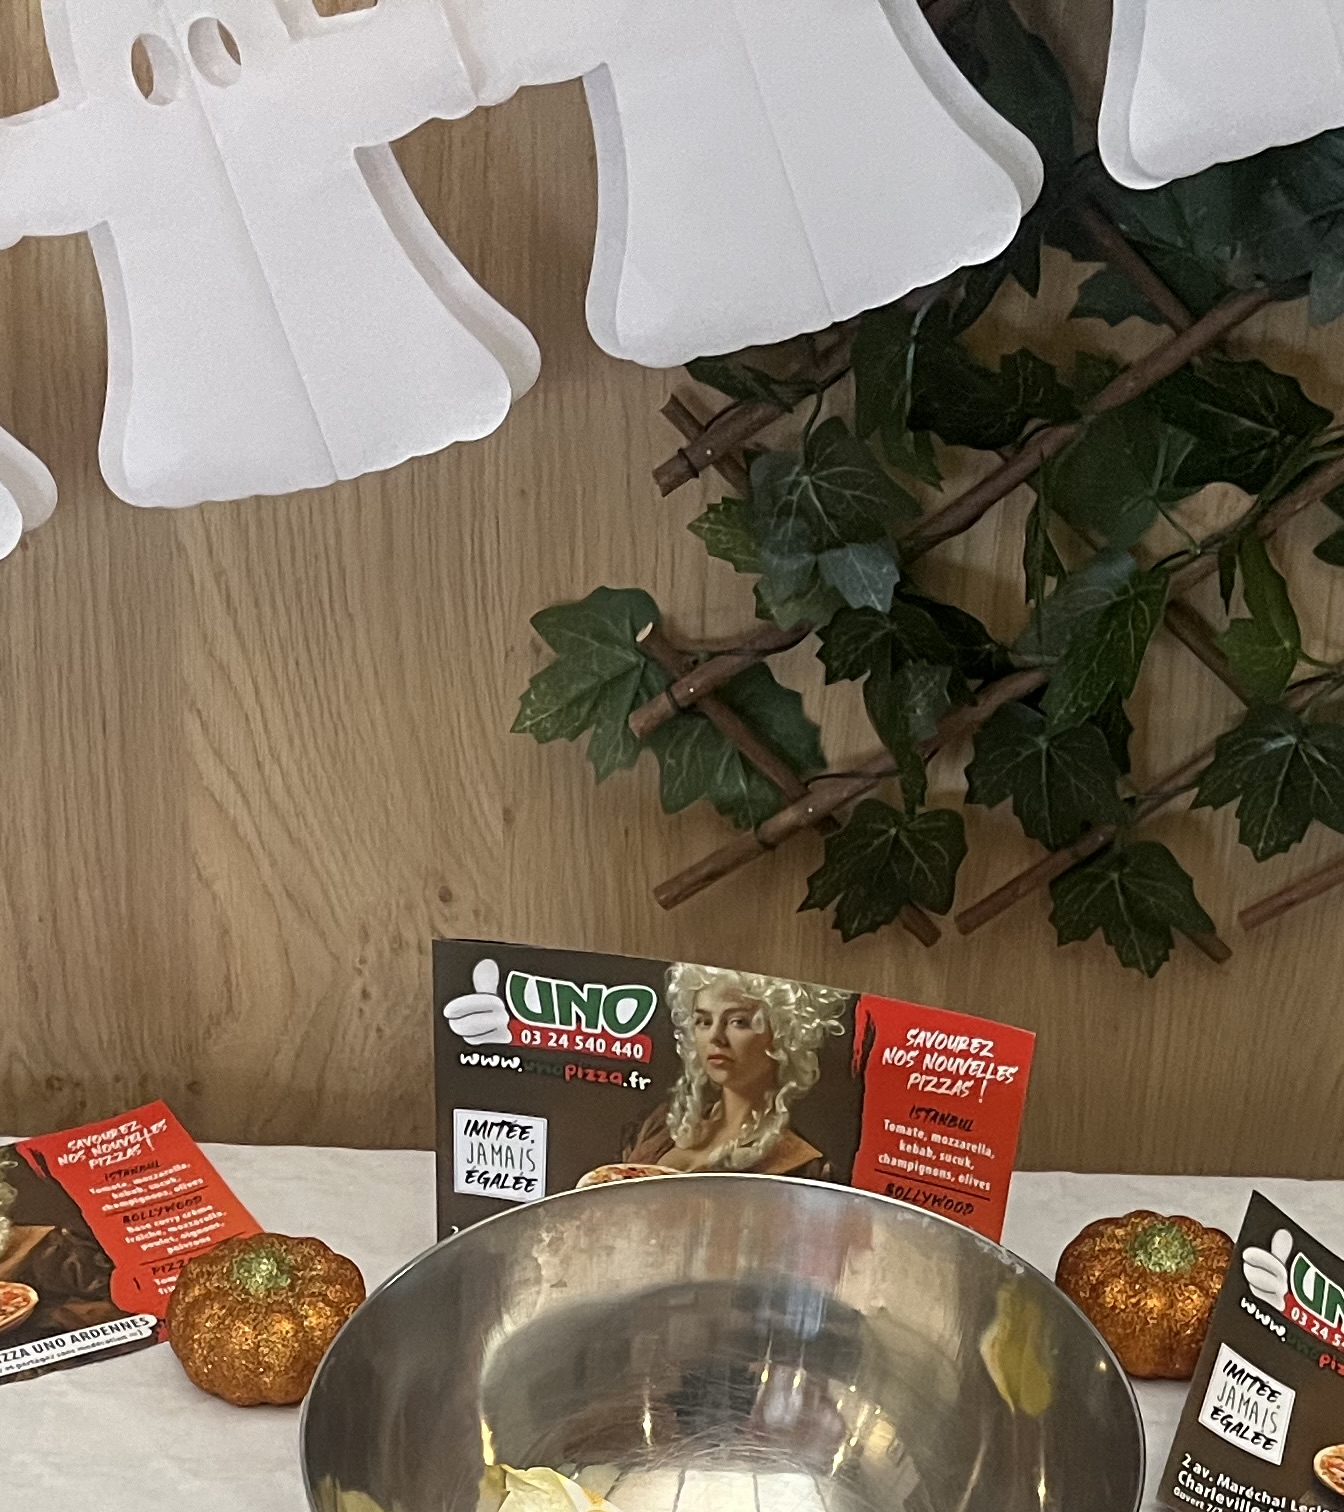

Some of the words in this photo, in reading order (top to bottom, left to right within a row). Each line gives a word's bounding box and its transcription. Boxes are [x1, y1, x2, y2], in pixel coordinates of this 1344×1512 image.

[506, 971, 657, 1037] UNO
[521, 1030, 541, 1045] 03
[548, 1032, 568, 1048] 24
[575, 1037, 605, 1052] 540
[611, 1041, 643, 1058] 440
[906, 1028, 994, 1057] SAVOUREZ
[882, 1047, 919, 1067] NOS
[923, 1053, 1018, 1084] NOUVELLES
[907, 1073, 974, 1097] PIZZAS
[909, 1105, 975, 1132] ISTANBUL
[58, 1150, 86, 1166] NOS
[91, 1119, 167, 1157] NOUVELLES
[68, 1121, 141, 1150] SAVOUREZ
[884, 1119, 928, 1141] Tomate,
[931, 1133, 995, 1159] mozzarella,
[89, 1144, 141, 1169] PIZZAS
[467, 1142, 536, 1172] JAMAIS
[899, 1140, 936, 1160] kebab,
[940, 1152, 975, 1170] sucuk,
[465, 1166, 537, 1192] ÉGALÉE
[878, 1153, 955, 1182] champignons,
[958, 1173, 991, 1191] olives
[123, 1195, 202, 1223] BOLLYWOOD
[884, 1183, 974, 1216] BOLLYWOOD
[152, 1259, 192, 1275] PIZZ
[31, 1339, 66, 1353] UNO
[70, 1317, 150, 1344] ARDENNES
[1291, 1307, 1308, 1325] 03
[1311, 1323, 1328, 1339] 24
[1216, 1382, 1278, 1434] JAMAIS
[1182, 1454, 1192, 1468] 2
[1193, 1464, 1214, 1482] av.
[1216, 1474, 1286, 1509] Maréchal
[1174, 1486, 1205, 1510] Ouvert
